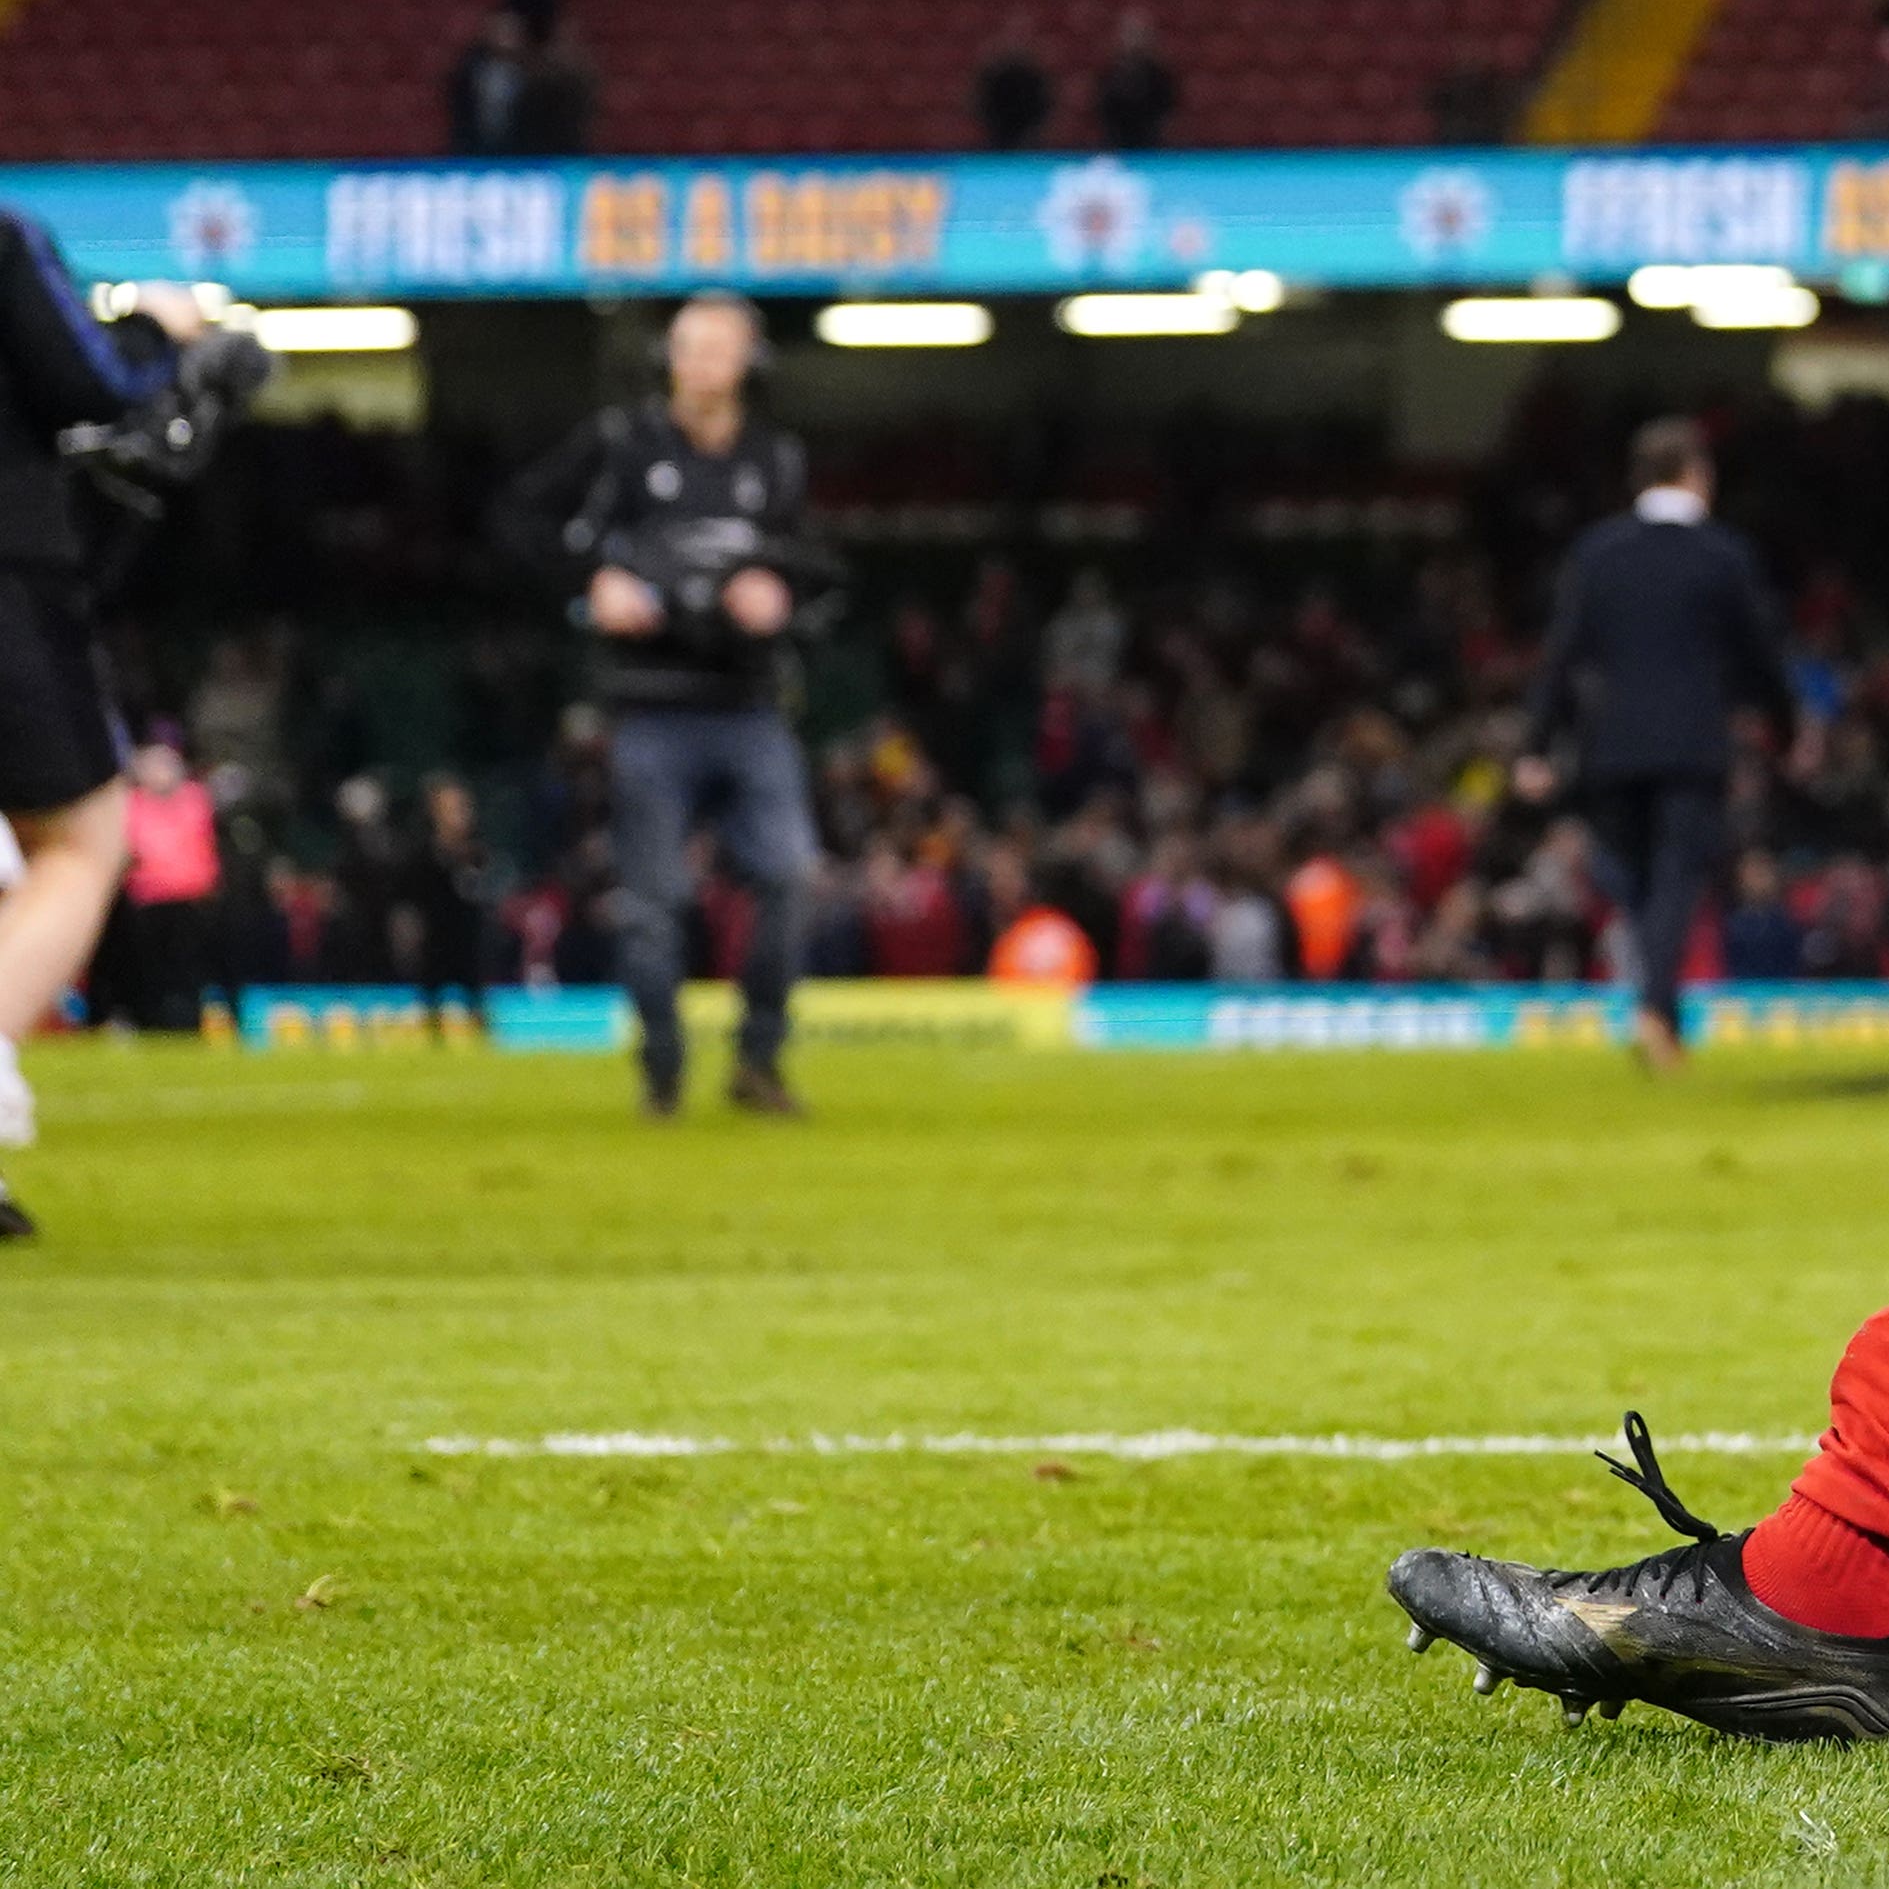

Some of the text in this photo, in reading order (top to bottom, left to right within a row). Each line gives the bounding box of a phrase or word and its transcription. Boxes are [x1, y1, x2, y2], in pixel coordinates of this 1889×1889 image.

[577, 171, 666, 277] AS
[682, 171, 734, 275] A
[745, 169, 941, 279] DAISY
